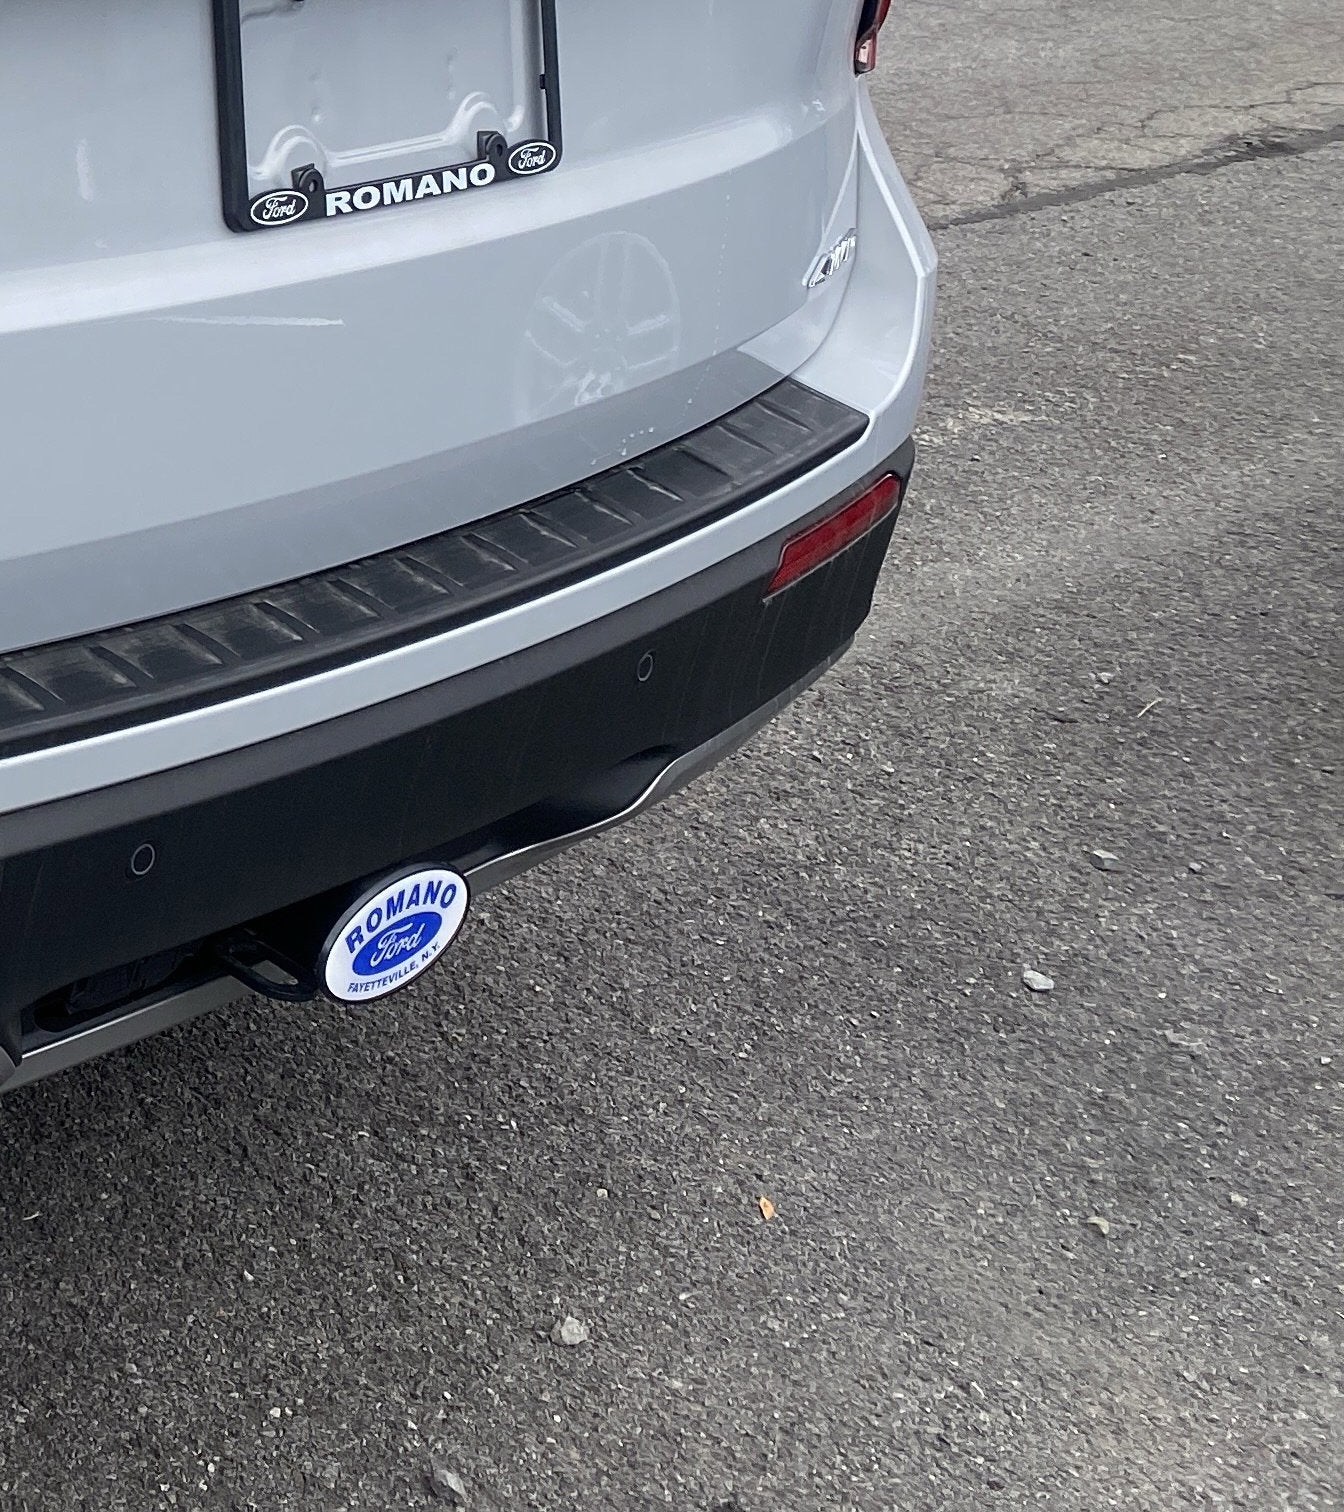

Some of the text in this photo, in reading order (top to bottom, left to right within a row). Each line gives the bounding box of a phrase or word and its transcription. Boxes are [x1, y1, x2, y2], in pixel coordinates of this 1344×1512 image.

[517, 144, 546, 169] Ford
[262, 196, 296, 220] Ford
[325, 162, 496, 217] ROMANO
[344, 880, 457, 954] ROMANO
[369, 922, 426, 968] Ford
[347, 960, 420, 993] FAYETTEVILLE,
